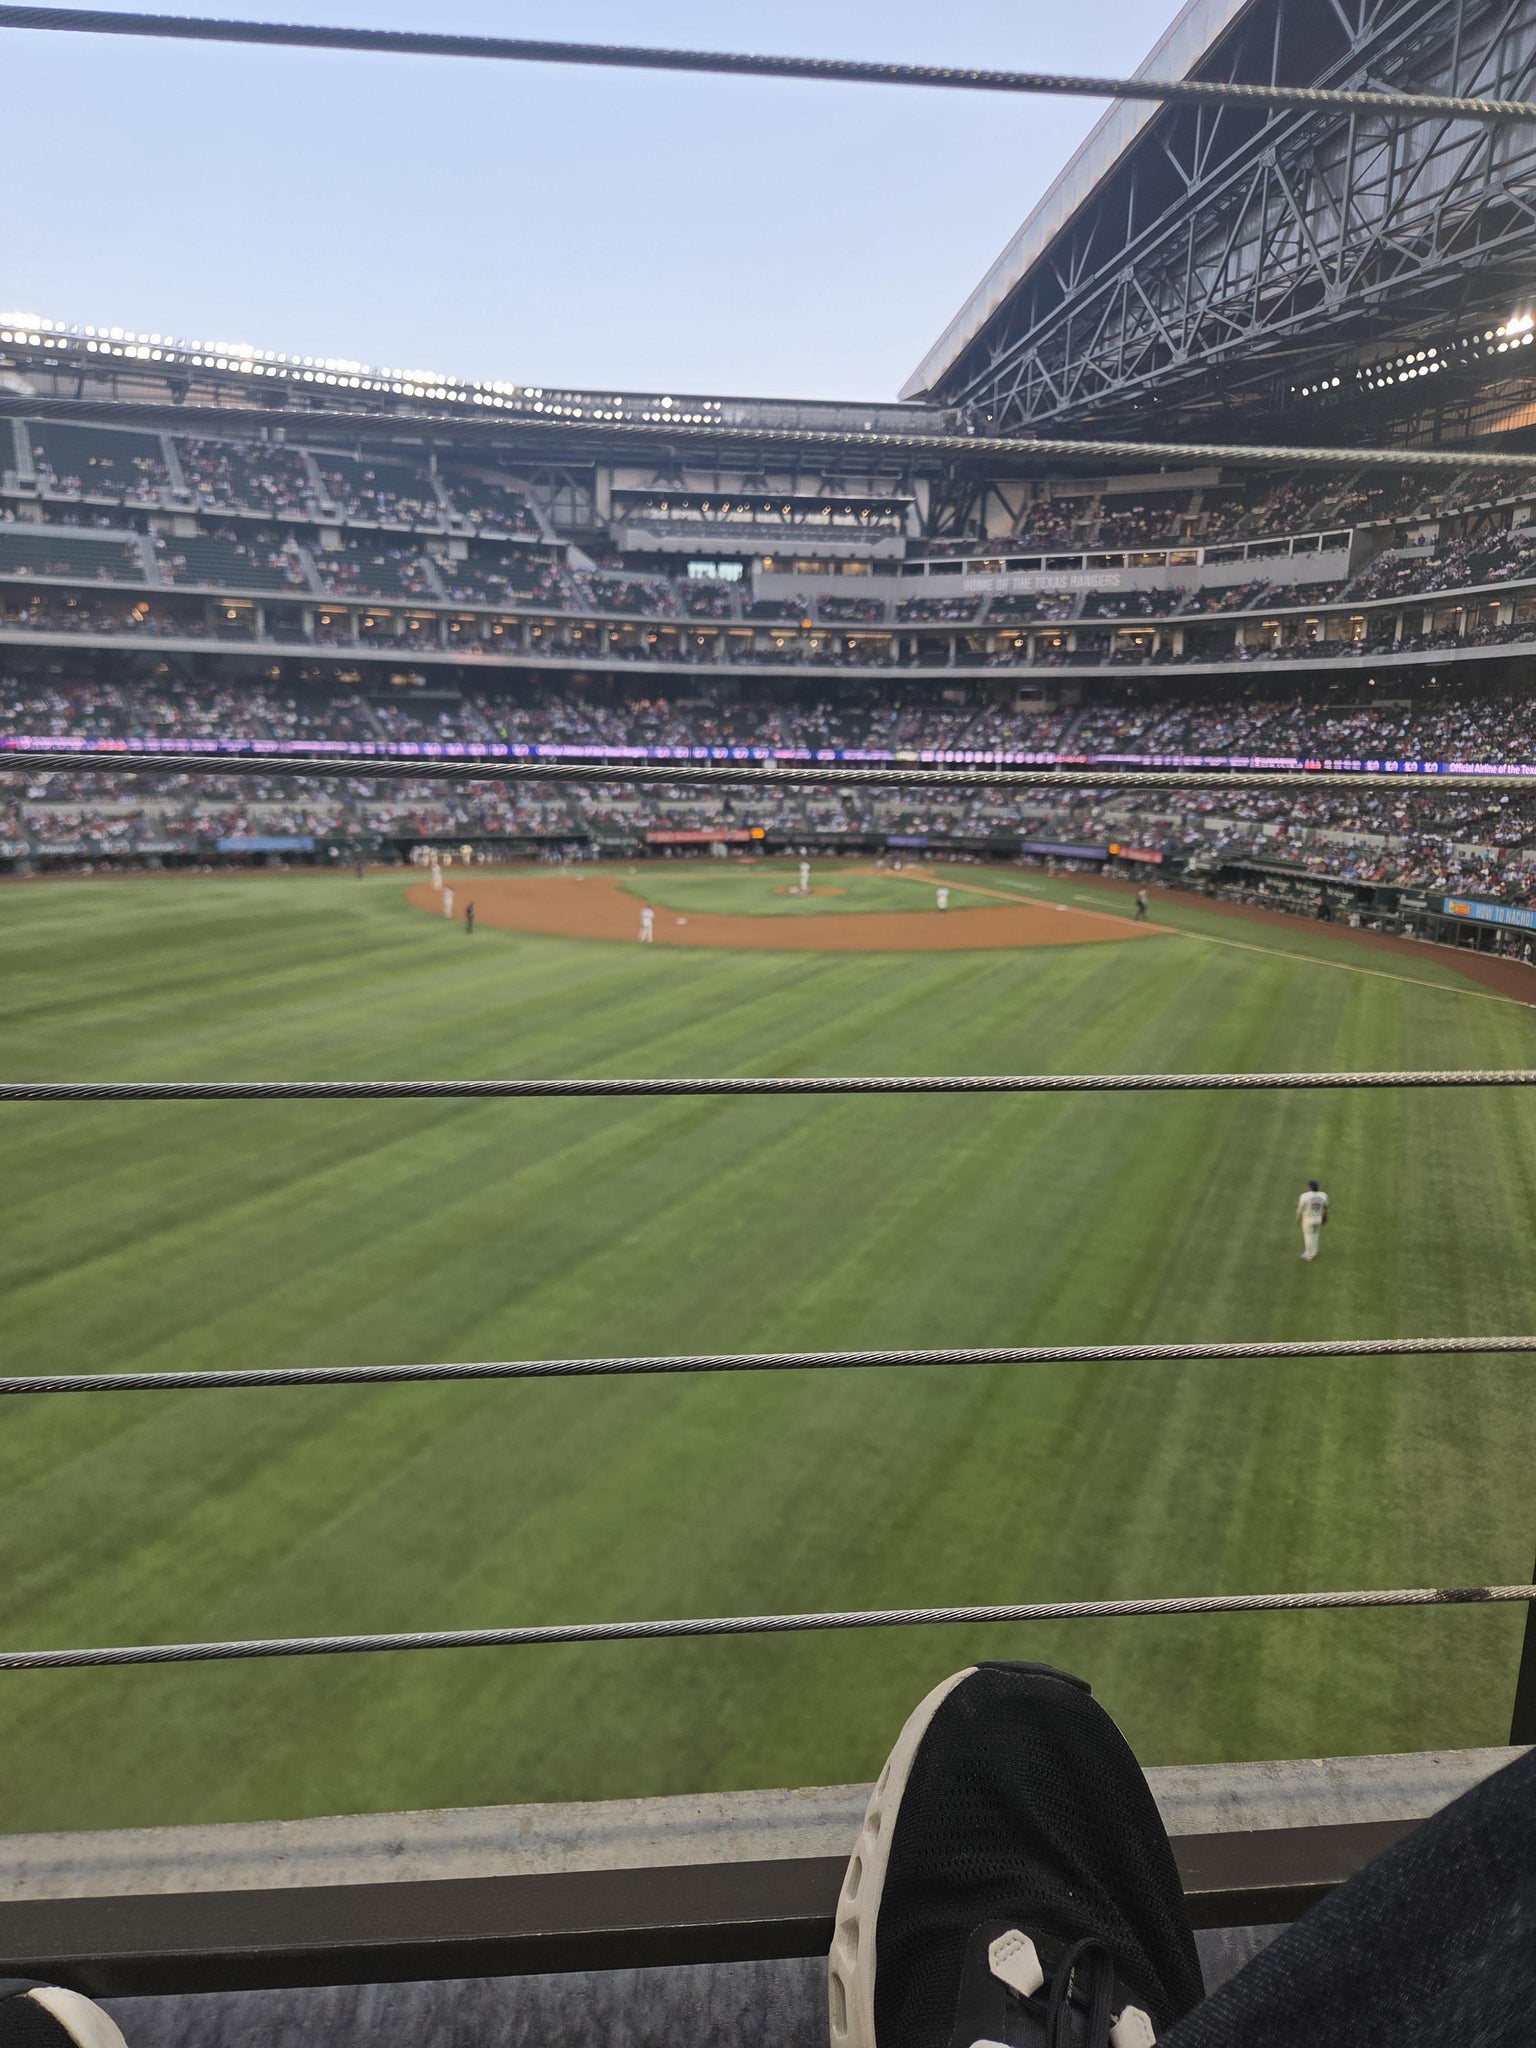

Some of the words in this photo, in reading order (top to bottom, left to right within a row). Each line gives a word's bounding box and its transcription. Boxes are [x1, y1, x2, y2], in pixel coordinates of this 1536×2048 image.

[964, 578, 993, 591] HOME
[996, 578, 1010, 590] OF
[1012, 577, 1032, 589] THE
[1035, 576, 1067, 589] TEXAS
[1070, 574, 1121, 588] RANGERS
[1449, 762, 1474, 773] Official
[1475, 763, 1497, 774] Airline
[1498, 763, 1507, 774] of
[1508, 763, 1520, 774] the
[1476, 904, 1493, 920] HOW
[1496, 907, 1504, 922] TO
